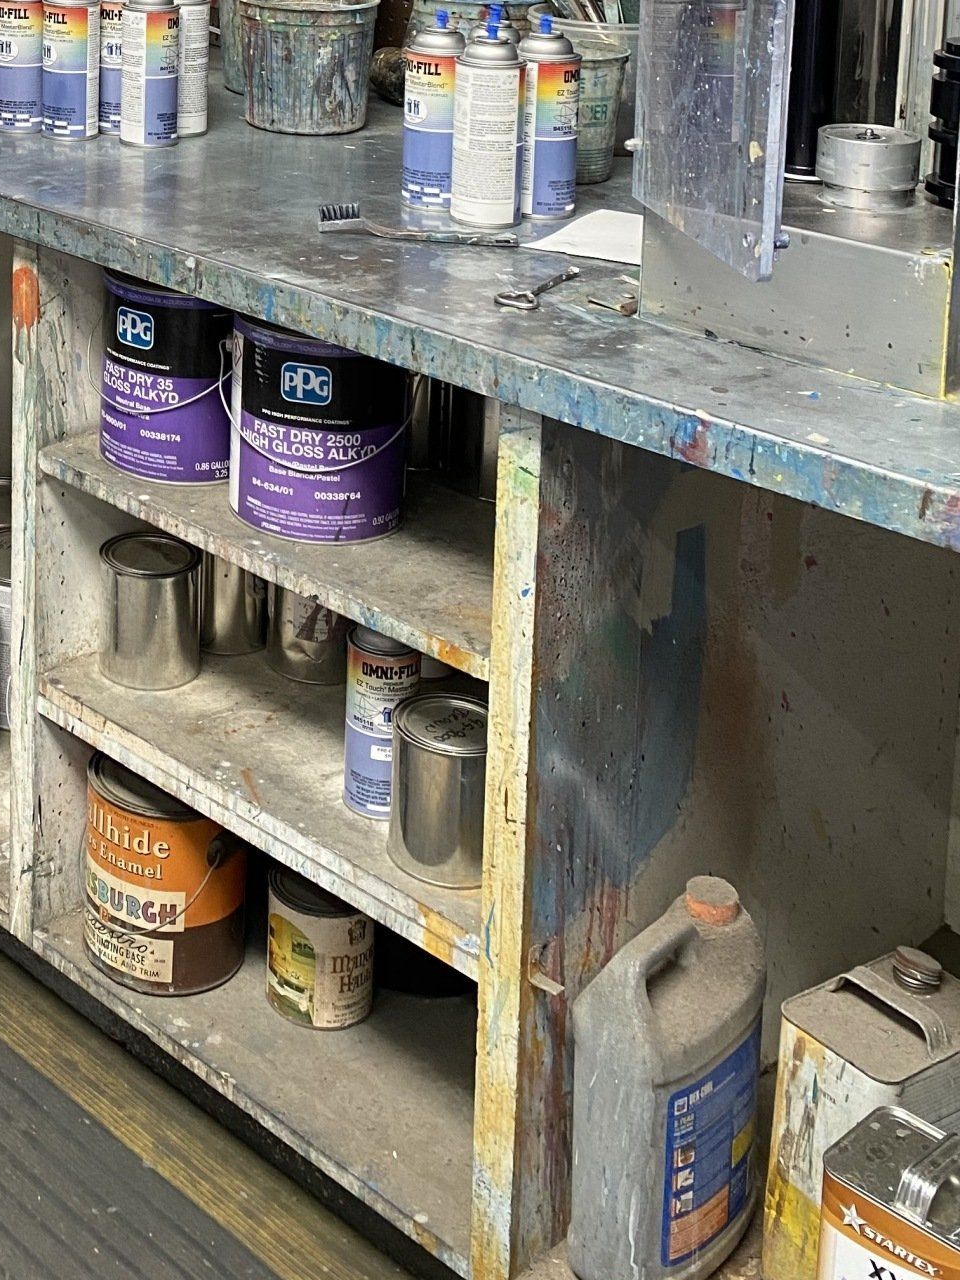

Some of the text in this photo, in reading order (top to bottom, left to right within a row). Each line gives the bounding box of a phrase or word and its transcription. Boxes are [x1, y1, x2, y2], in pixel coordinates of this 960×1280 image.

[119, 312, 151, 342] PPG
[104, 373, 179, 404] GLOSS ALKYD
[106, 360, 173, 391] FAST DRY 35
[284, 368, 329, 398] PPG
[140, 429, 181, 442] 00338174
[242, 428, 376, 460] HIGH GLOSS ALKYD
[254, 420, 361, 447] FAST DRY 2500
[195, 460, 230, 471] 0.86 GALLO
[269, 466, 340, 482] Base Blanca/Pastel
[100, 844, 163, 880] Enamel
[121, 960, 137, 972] AND
[140, 967, 160, 978] TRIM
[126, 950, 145, 966] BASE
[863, 1227, 938, 1276] STARTEX
